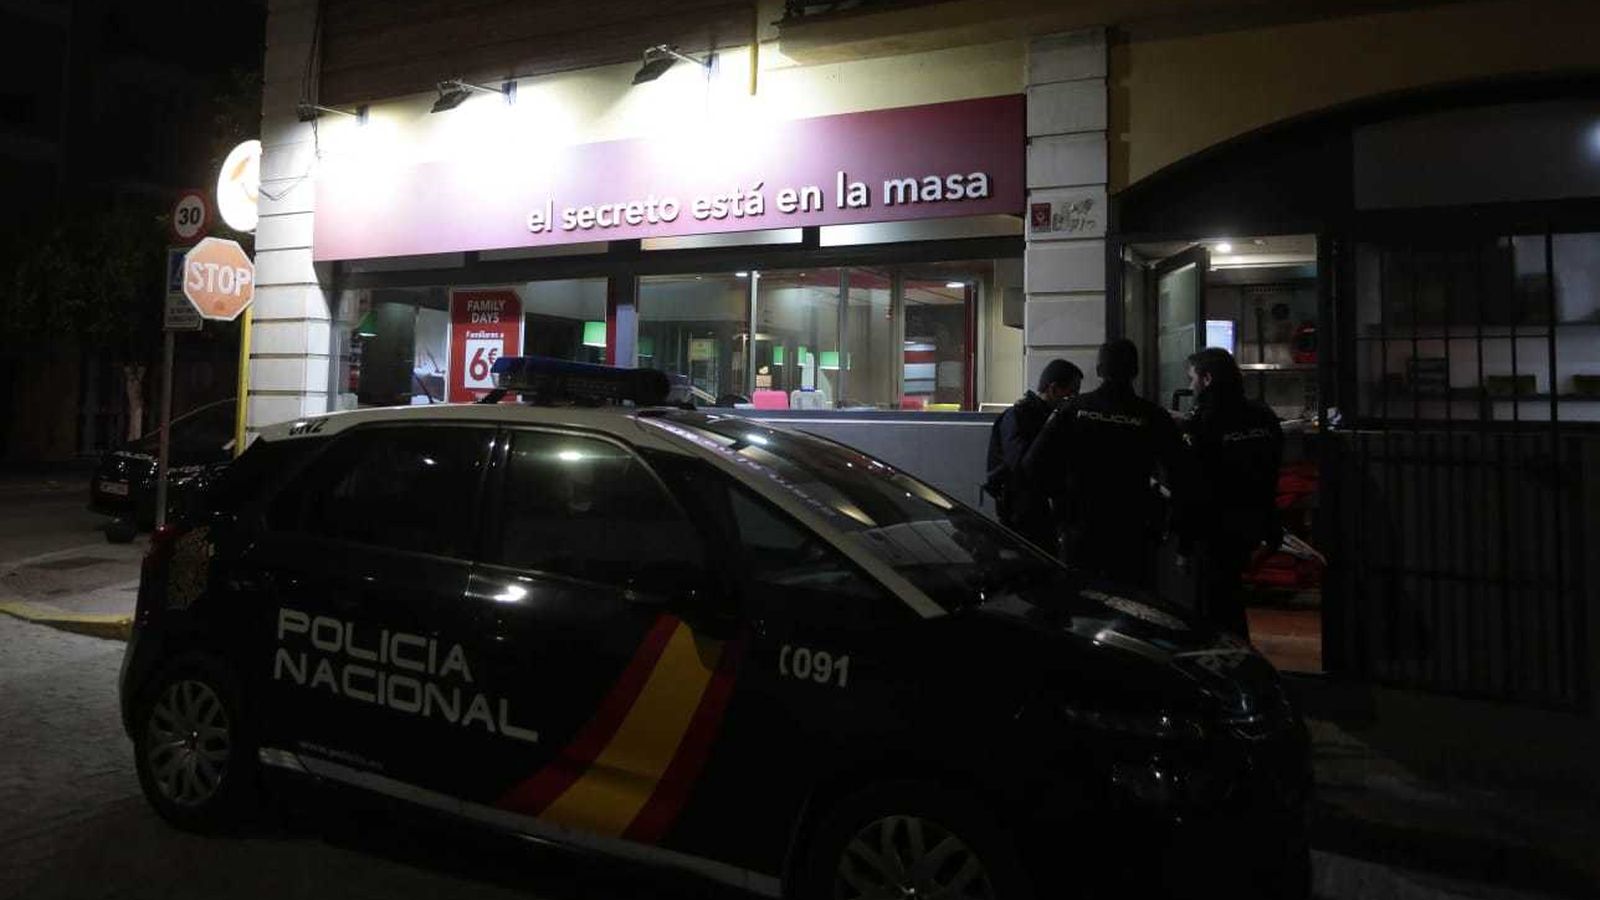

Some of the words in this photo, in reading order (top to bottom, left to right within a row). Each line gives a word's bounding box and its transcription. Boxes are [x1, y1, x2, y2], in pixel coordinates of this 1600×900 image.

[179, 207, 201, 225] 30
[526, 194, 553, 232] el
[562, 192, 680, 230] secreto
[691, 181, 765, 221] está
[775, 184, 823, 213] en
[835, 171, 869, 209] la
[883, 170, 991, 205] masa
[188, 263, 250, 297] STOP
[467, 299, 505, 312] FAMILY
[471, 312, 499, 324] DAYS
[792, 647, 850, 688] 091
[273, 646, 540, 743] NACIONAL
